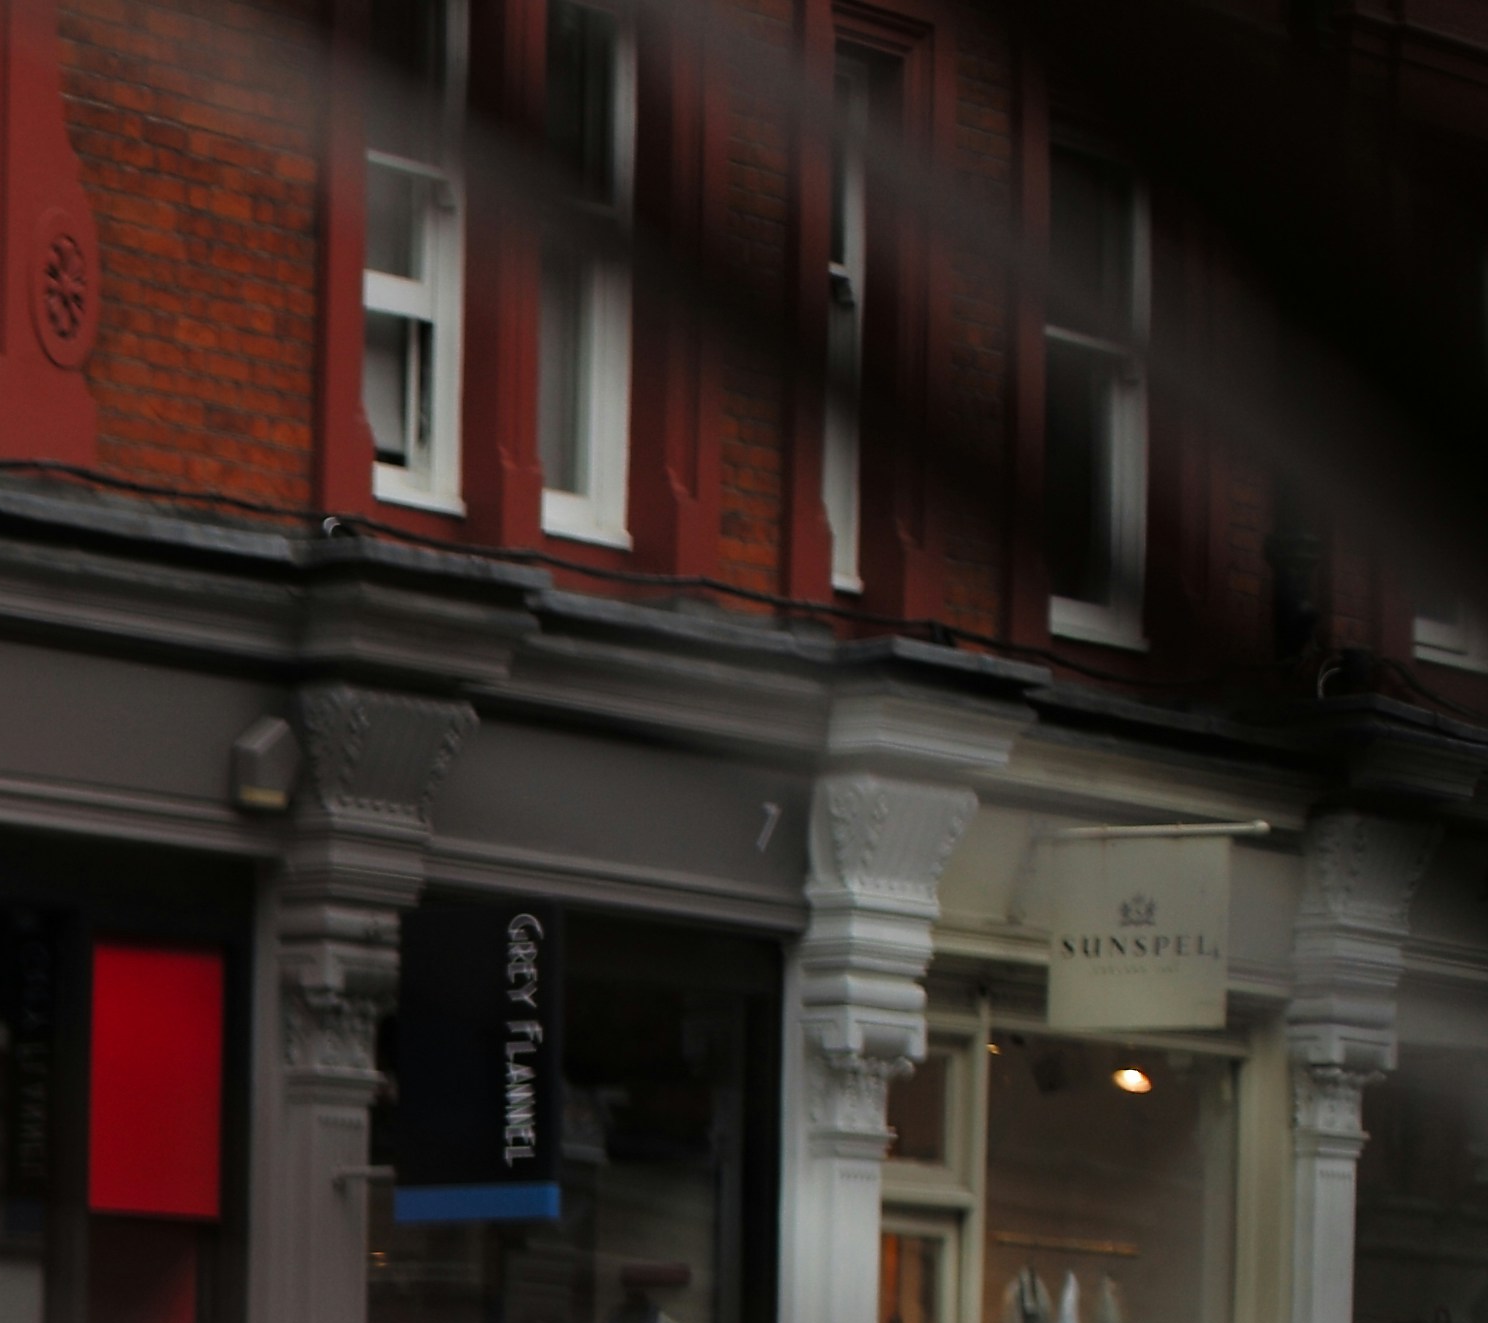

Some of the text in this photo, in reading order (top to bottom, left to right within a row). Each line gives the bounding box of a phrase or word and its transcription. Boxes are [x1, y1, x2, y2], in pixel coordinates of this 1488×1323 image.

[1061, 934, 1213, 960] SUNSPEL
[503, 912, 545, 1169] GREY FLANNEL
